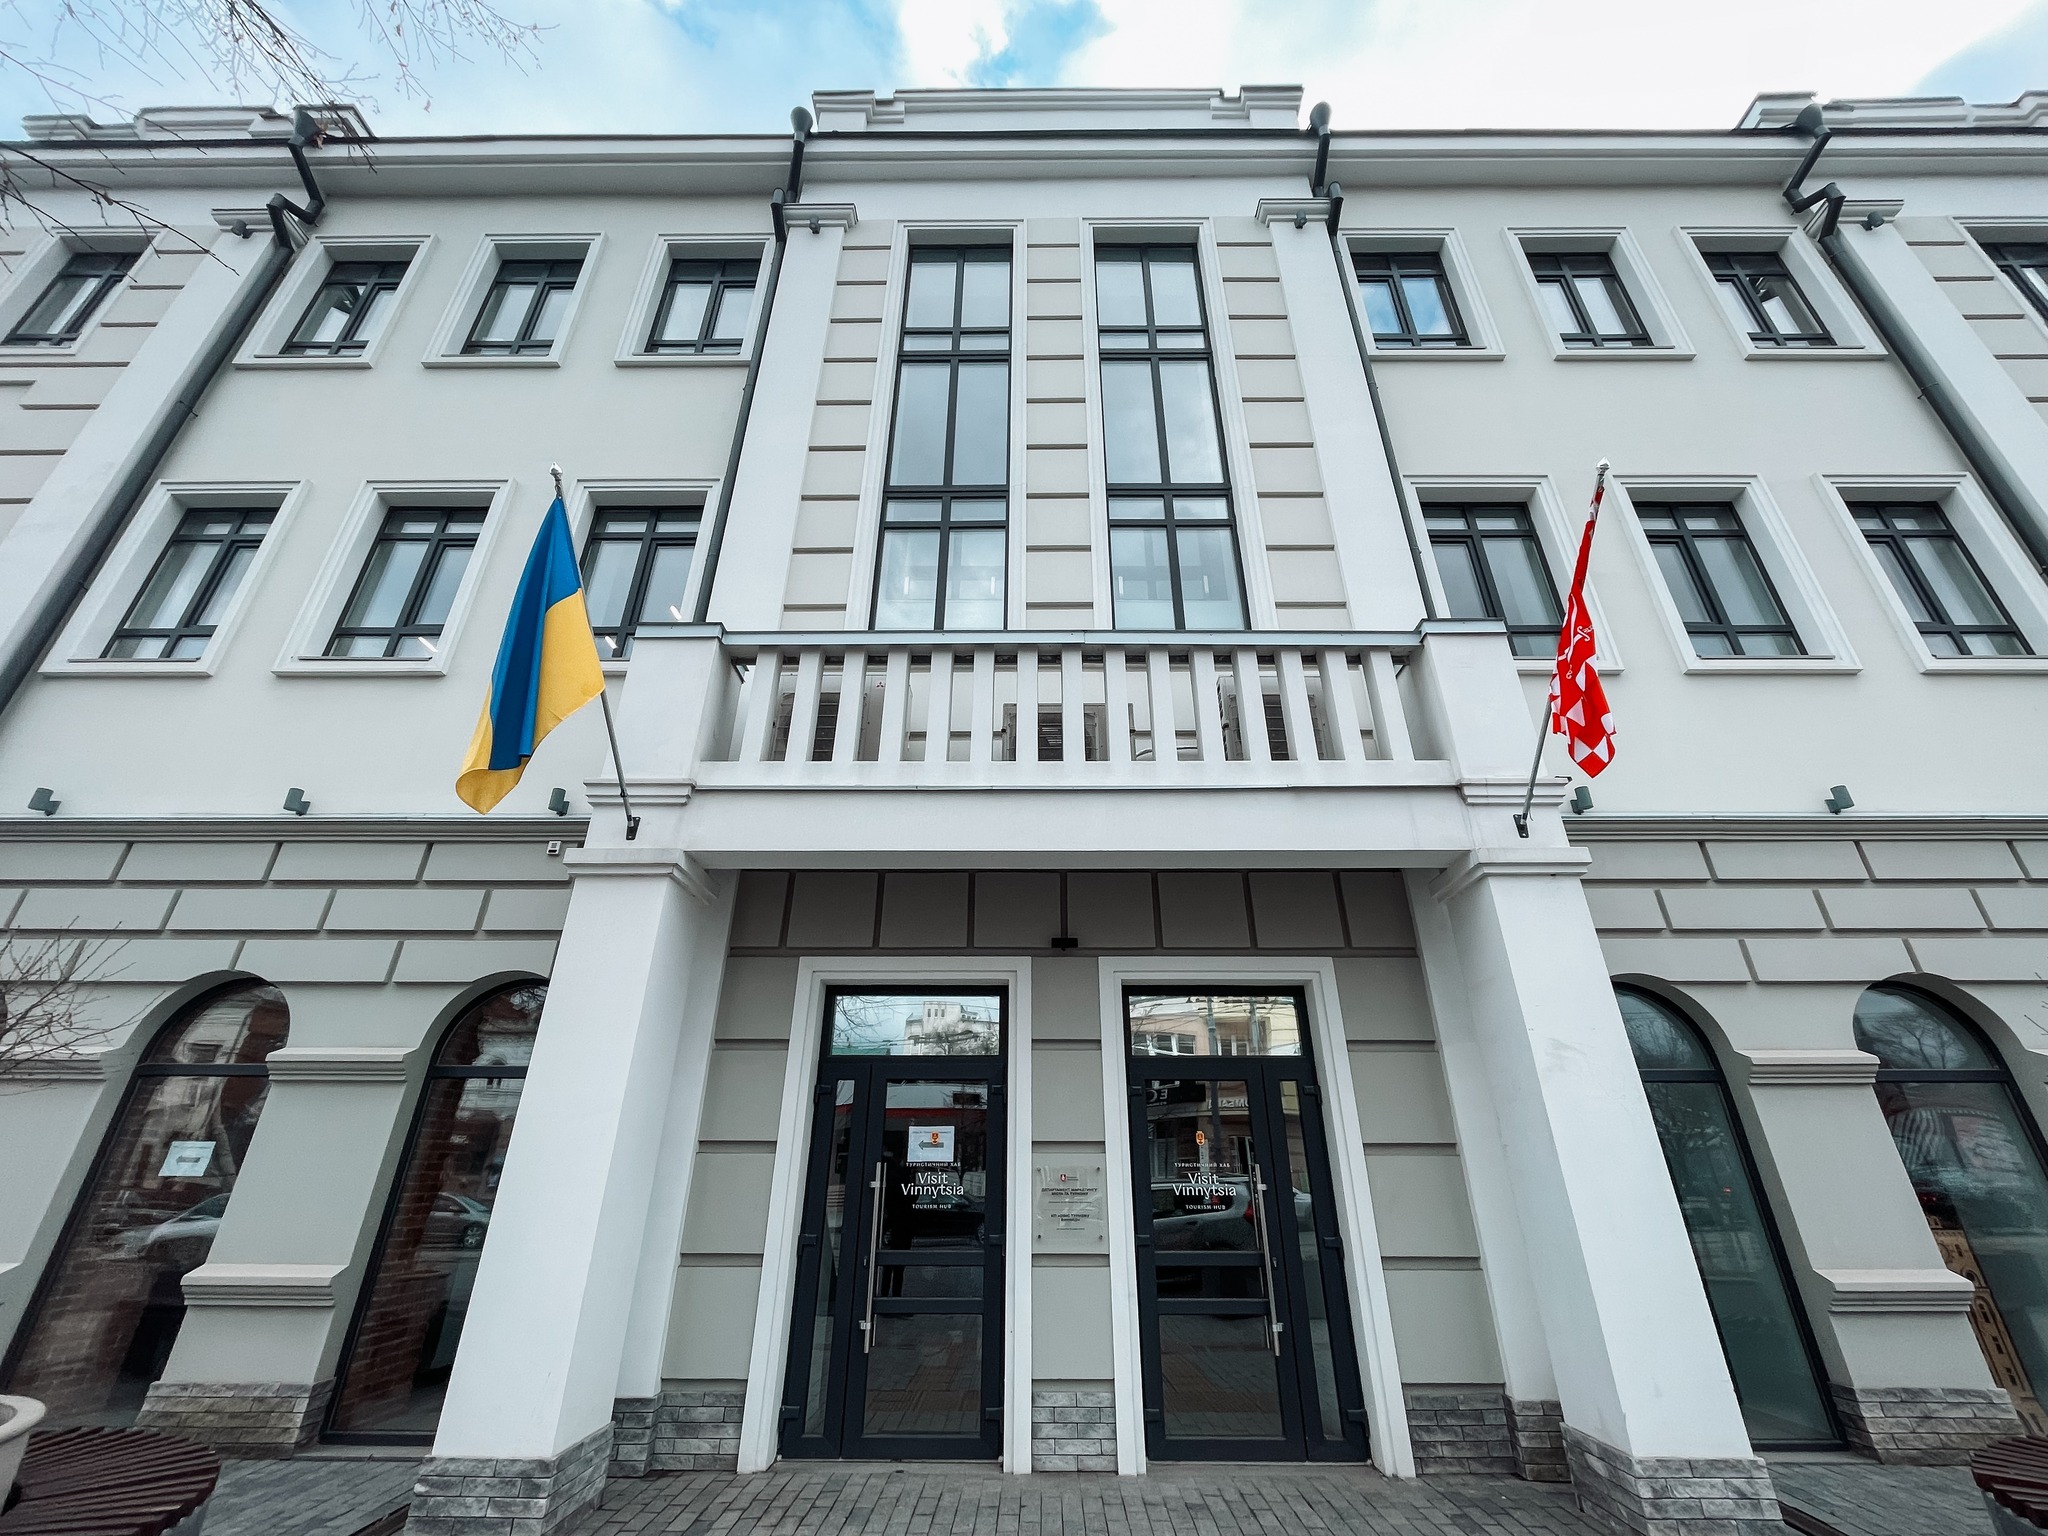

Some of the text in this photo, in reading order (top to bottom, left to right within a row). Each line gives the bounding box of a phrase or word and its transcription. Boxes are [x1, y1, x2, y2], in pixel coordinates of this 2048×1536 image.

[918, 1172, 948, 1184] Visit
[1187, 1172, 1219, 1185] Visit
[901, 1183, 964, 1199] Vinnytsia
[1172, 1184, 1237, 1200] Vinnytsia
